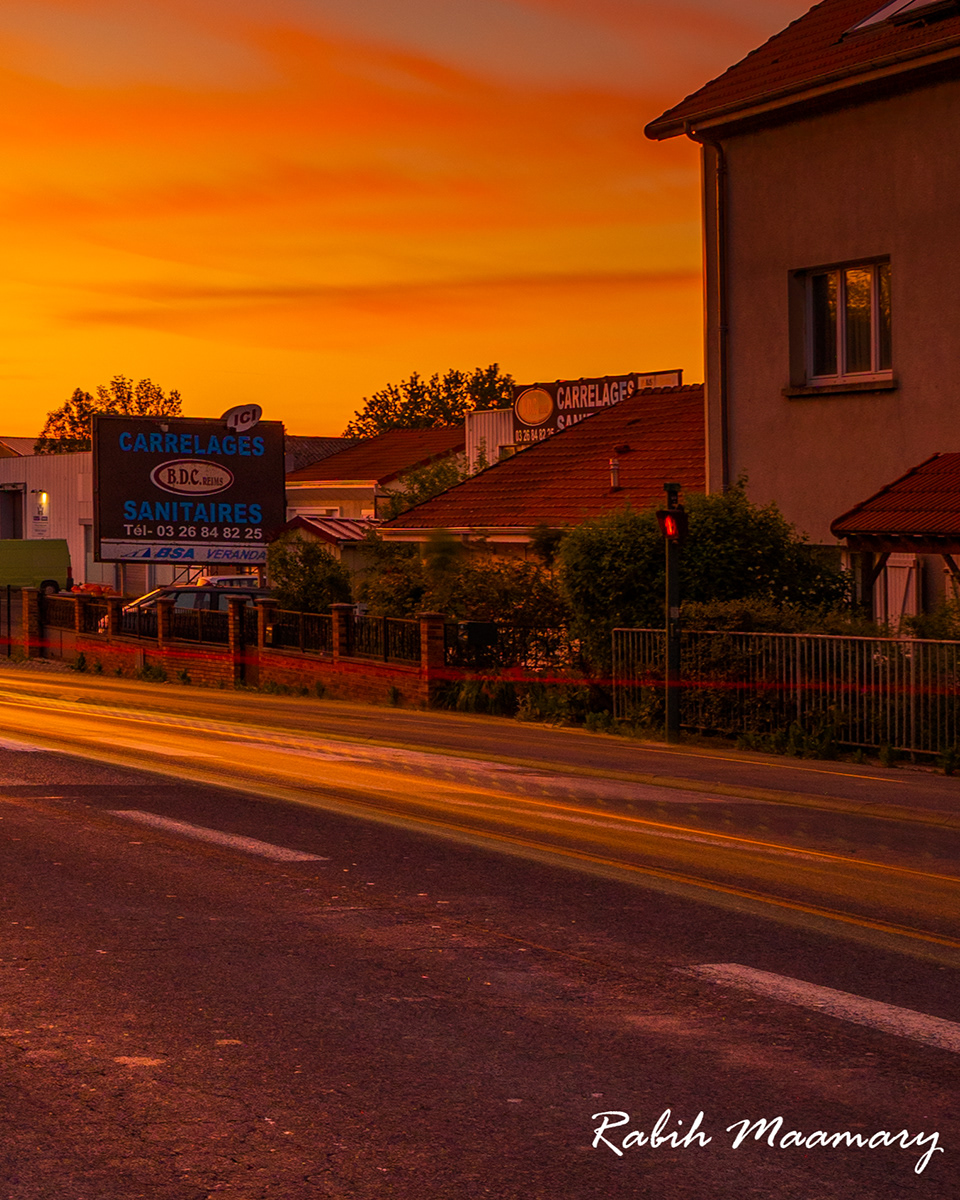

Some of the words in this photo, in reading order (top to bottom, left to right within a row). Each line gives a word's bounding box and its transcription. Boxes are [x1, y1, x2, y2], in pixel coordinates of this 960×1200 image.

[557, 380, 635, 410] CARRELAGES
[233, 408, 257, 427] ICI
[119, 432, 265, 457] CARRELAGES
[202, 476, 224, 486] REIMS
[123, 500, 263, 524] SANITAIRES
[156, 525, 174, 537] 03
[178, 526, 196, 538] 26
[200, 527, 219, 538] 84
[223, 527, 240, 539] 82
[244, 528, 262, 539] 25
[155, 547, 195, 560] BSA
